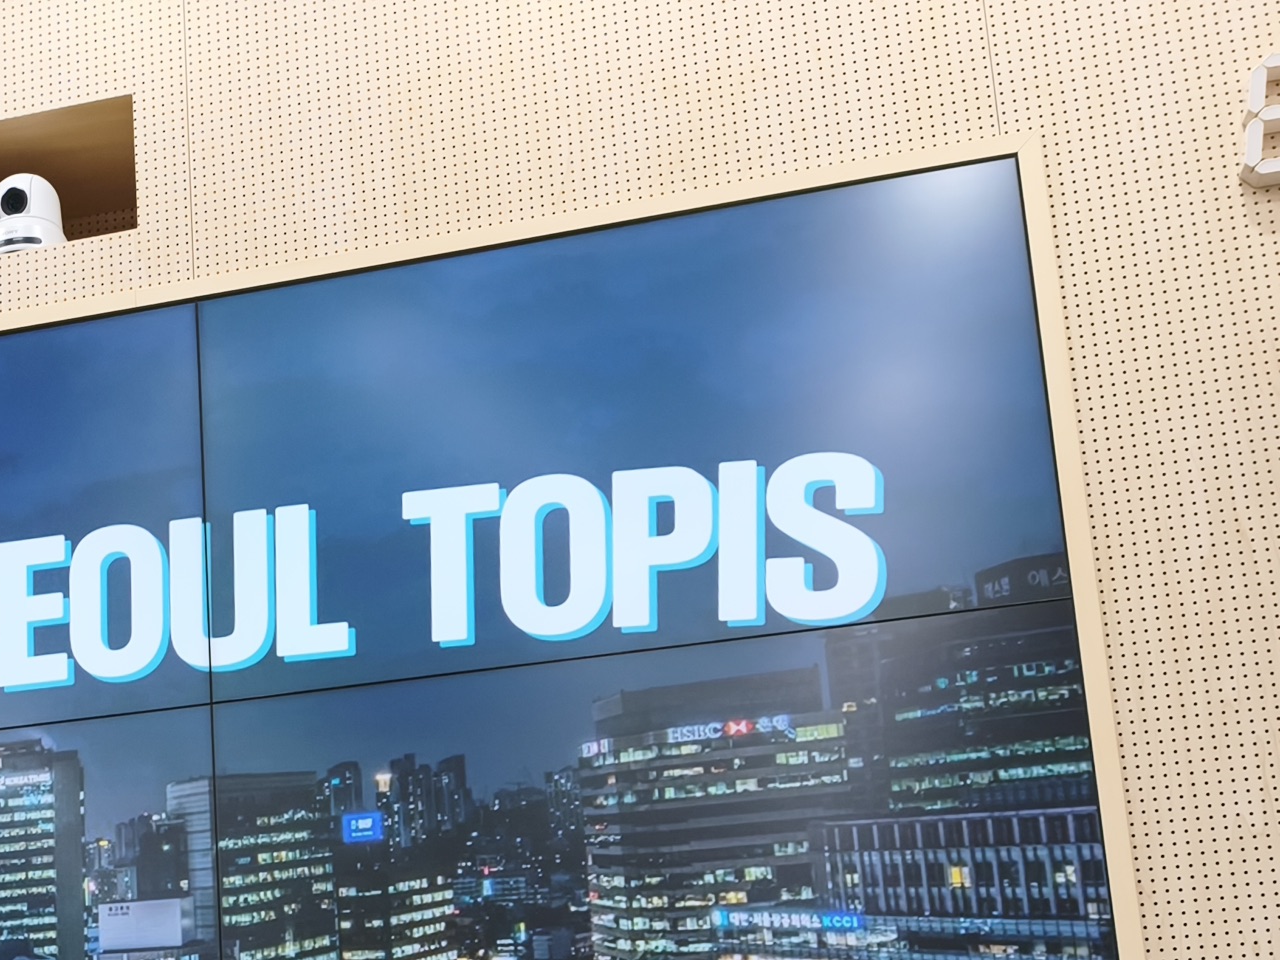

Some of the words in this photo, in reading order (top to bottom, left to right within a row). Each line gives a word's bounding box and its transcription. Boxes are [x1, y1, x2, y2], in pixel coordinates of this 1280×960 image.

[402, 451, 888, 648] TOPIS
[668, 722, 723, 744] HSBC
[823, 915, 859, 928] KCCI
